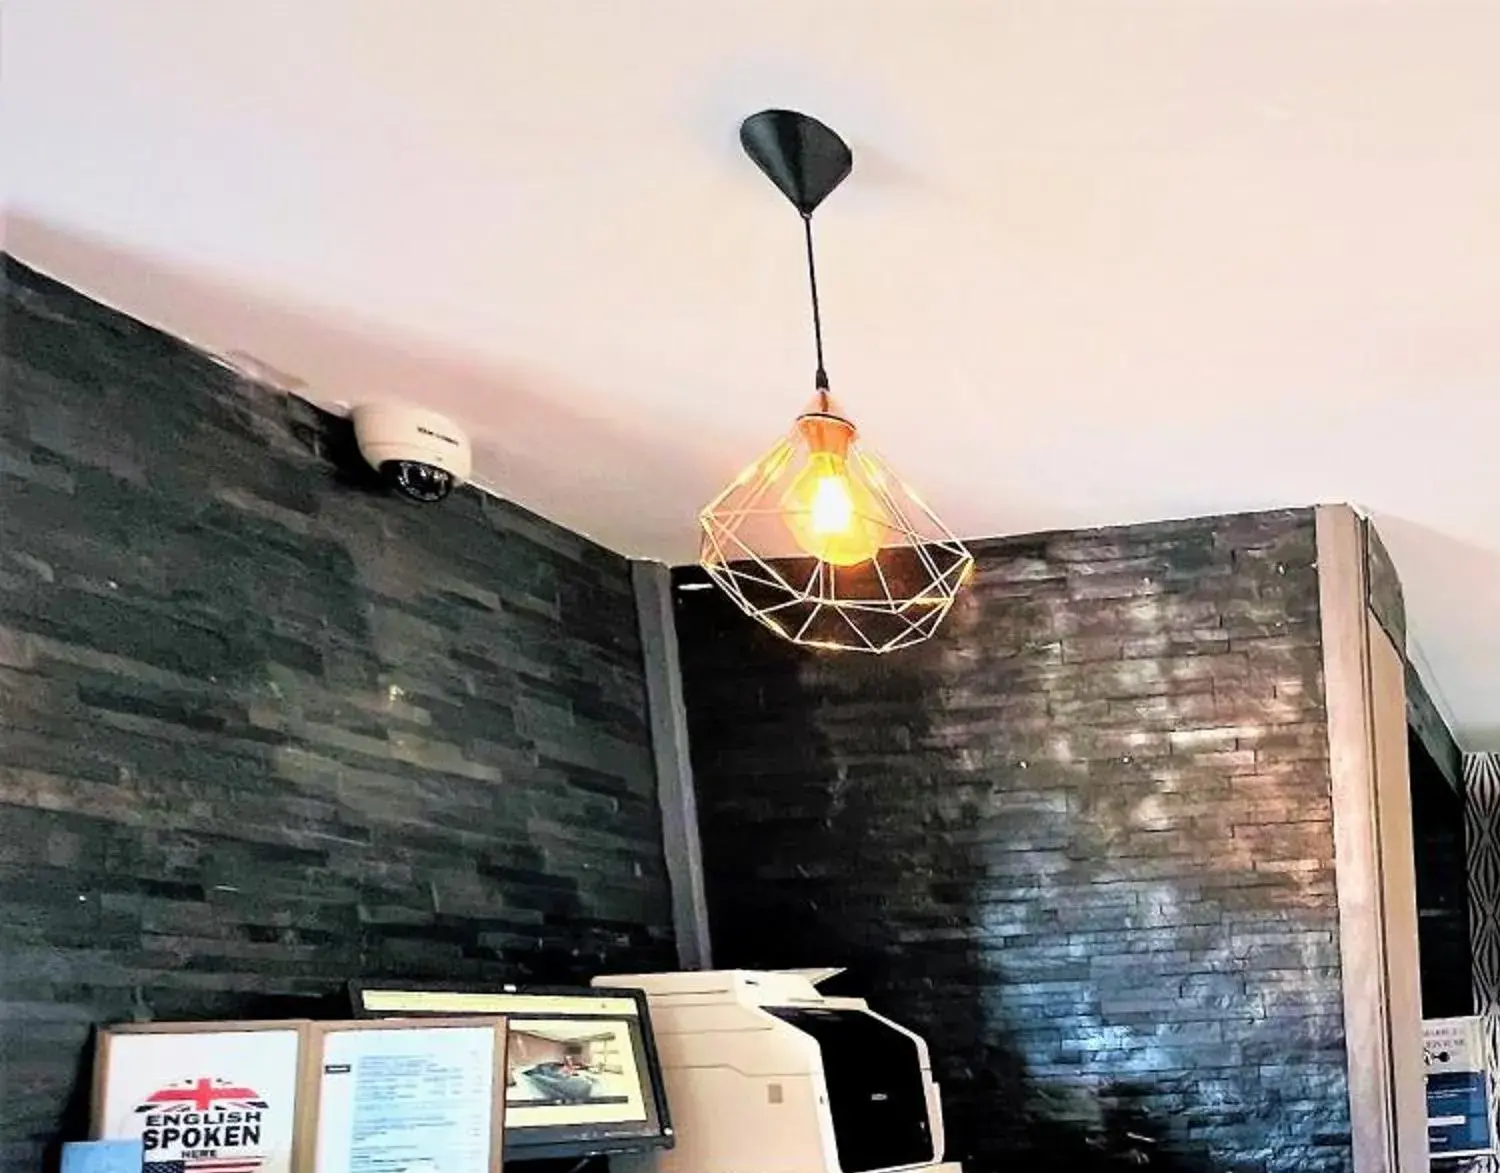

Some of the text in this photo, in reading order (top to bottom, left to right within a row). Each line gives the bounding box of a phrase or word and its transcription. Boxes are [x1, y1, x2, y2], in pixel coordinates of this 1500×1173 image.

[145, 1111, 262, 1127] ENGLISH
[142, 1126, 262, 1151] SPOKEN
[181, 1149, 218, 1159] HERE
